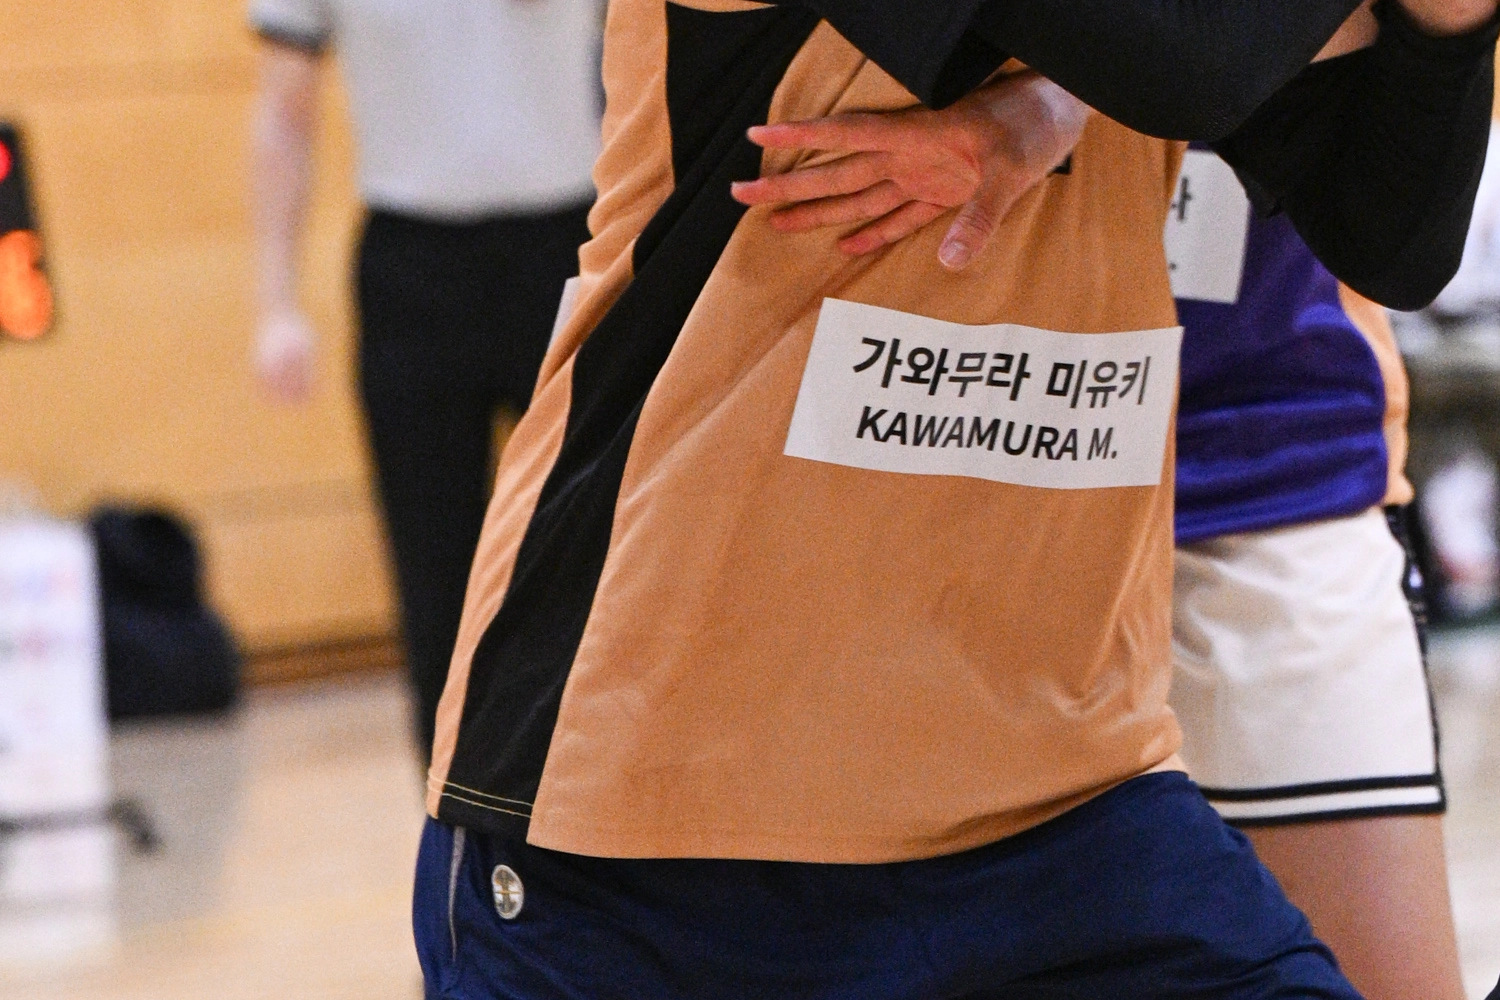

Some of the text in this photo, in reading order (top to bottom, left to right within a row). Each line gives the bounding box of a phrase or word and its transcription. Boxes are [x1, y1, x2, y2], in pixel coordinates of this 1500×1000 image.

[852, 336, 1152, 409] 가와무라 미유키
[856, 406, 1119, 461] KAWAMURA M.
